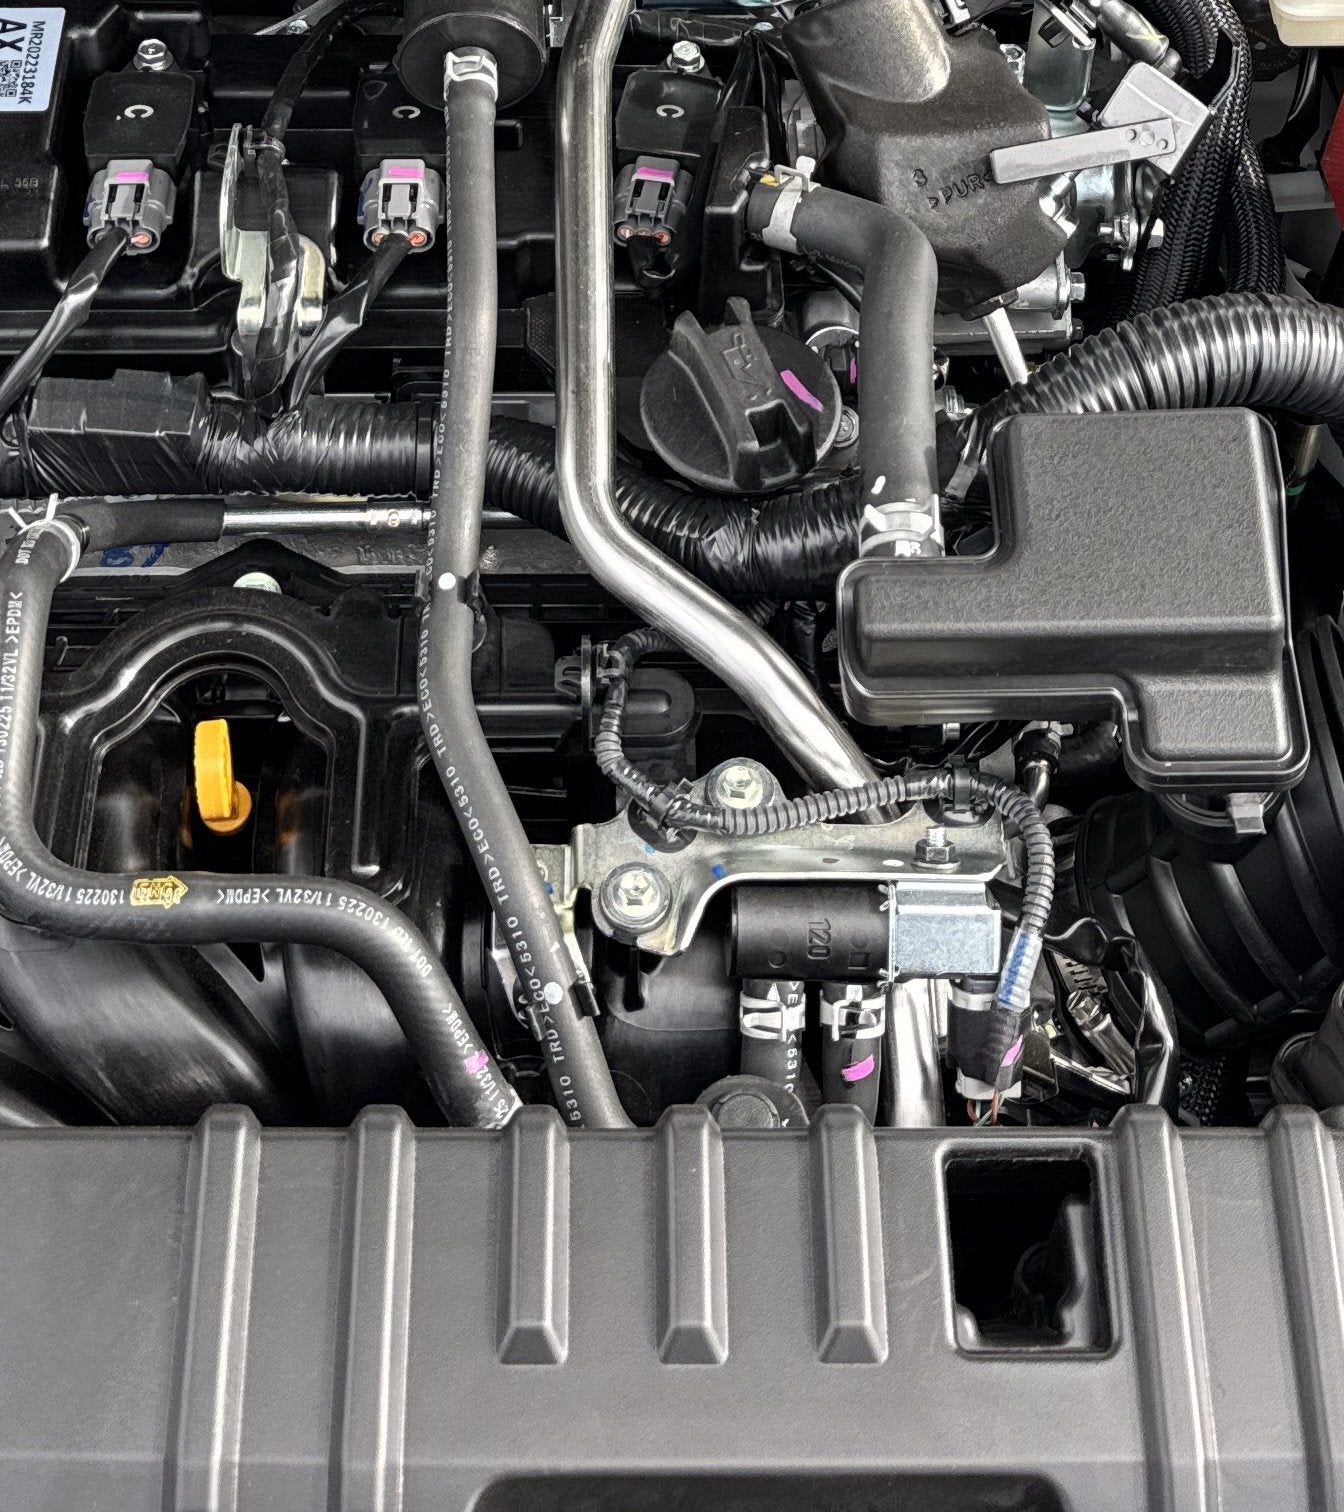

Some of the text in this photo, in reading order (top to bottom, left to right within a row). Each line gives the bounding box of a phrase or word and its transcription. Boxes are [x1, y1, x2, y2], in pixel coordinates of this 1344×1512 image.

[17, 20, 46, 105] MR20223184K
[75, 887, 126, 906] 130225
[336, 895, 391, 930] 130225
[807, 917, 832, 961] 120
